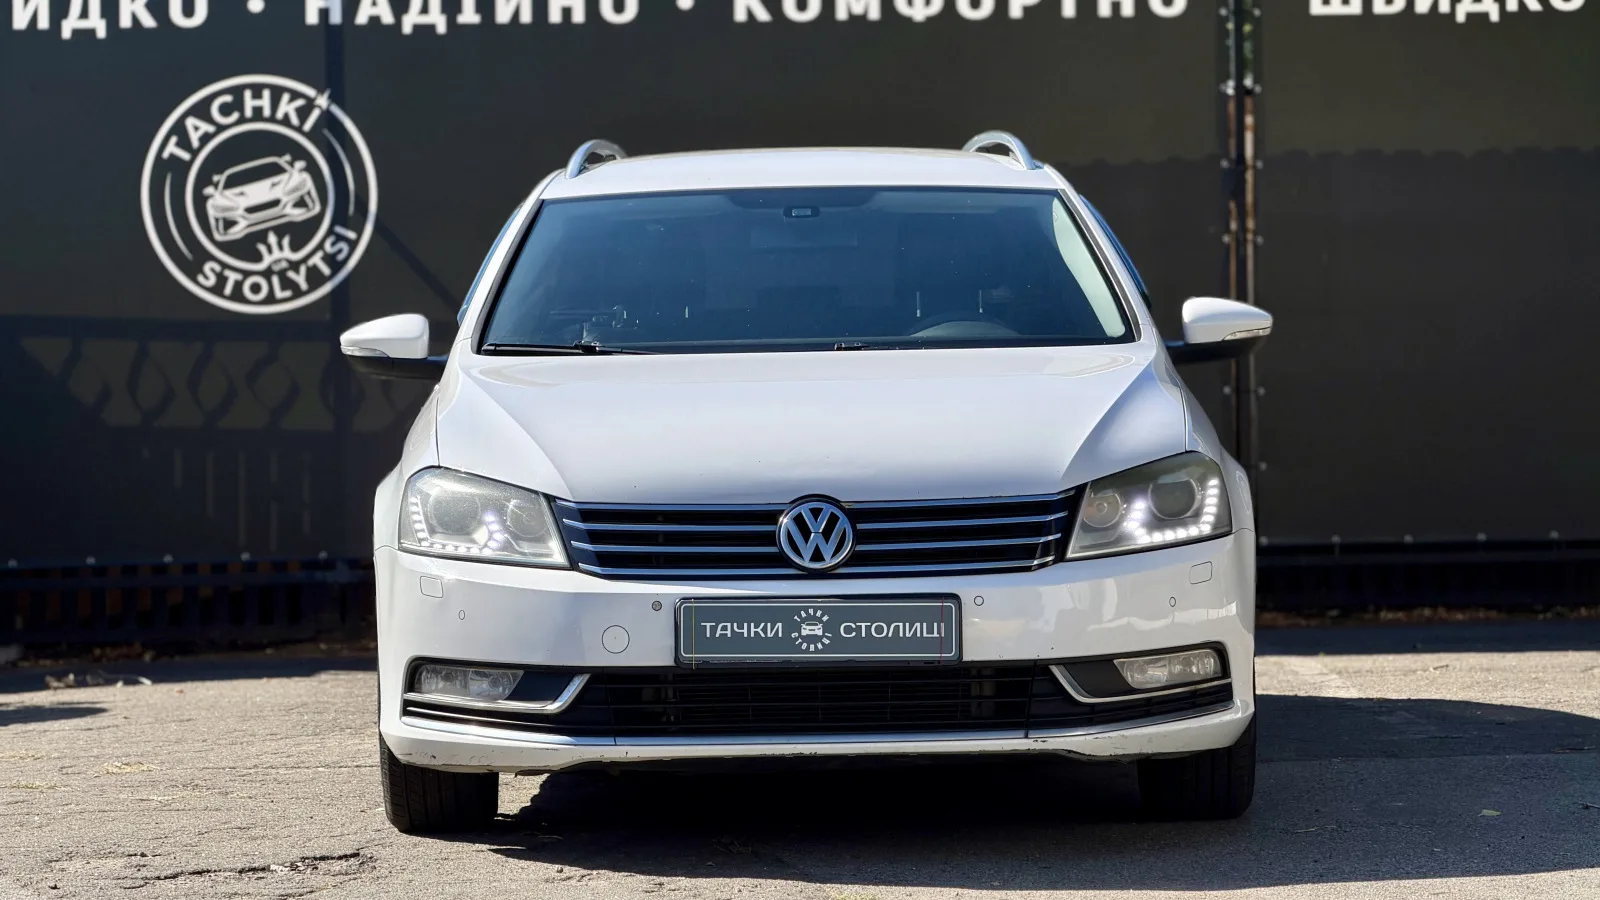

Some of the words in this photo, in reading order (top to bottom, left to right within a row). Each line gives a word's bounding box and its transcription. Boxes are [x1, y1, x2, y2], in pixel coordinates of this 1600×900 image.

[196, 225, 357, 302] STOLYTSI
[701, 622, 782, 637] ТАЧКИ
[839, 622, 945, 637] СТОЛИЦІ
